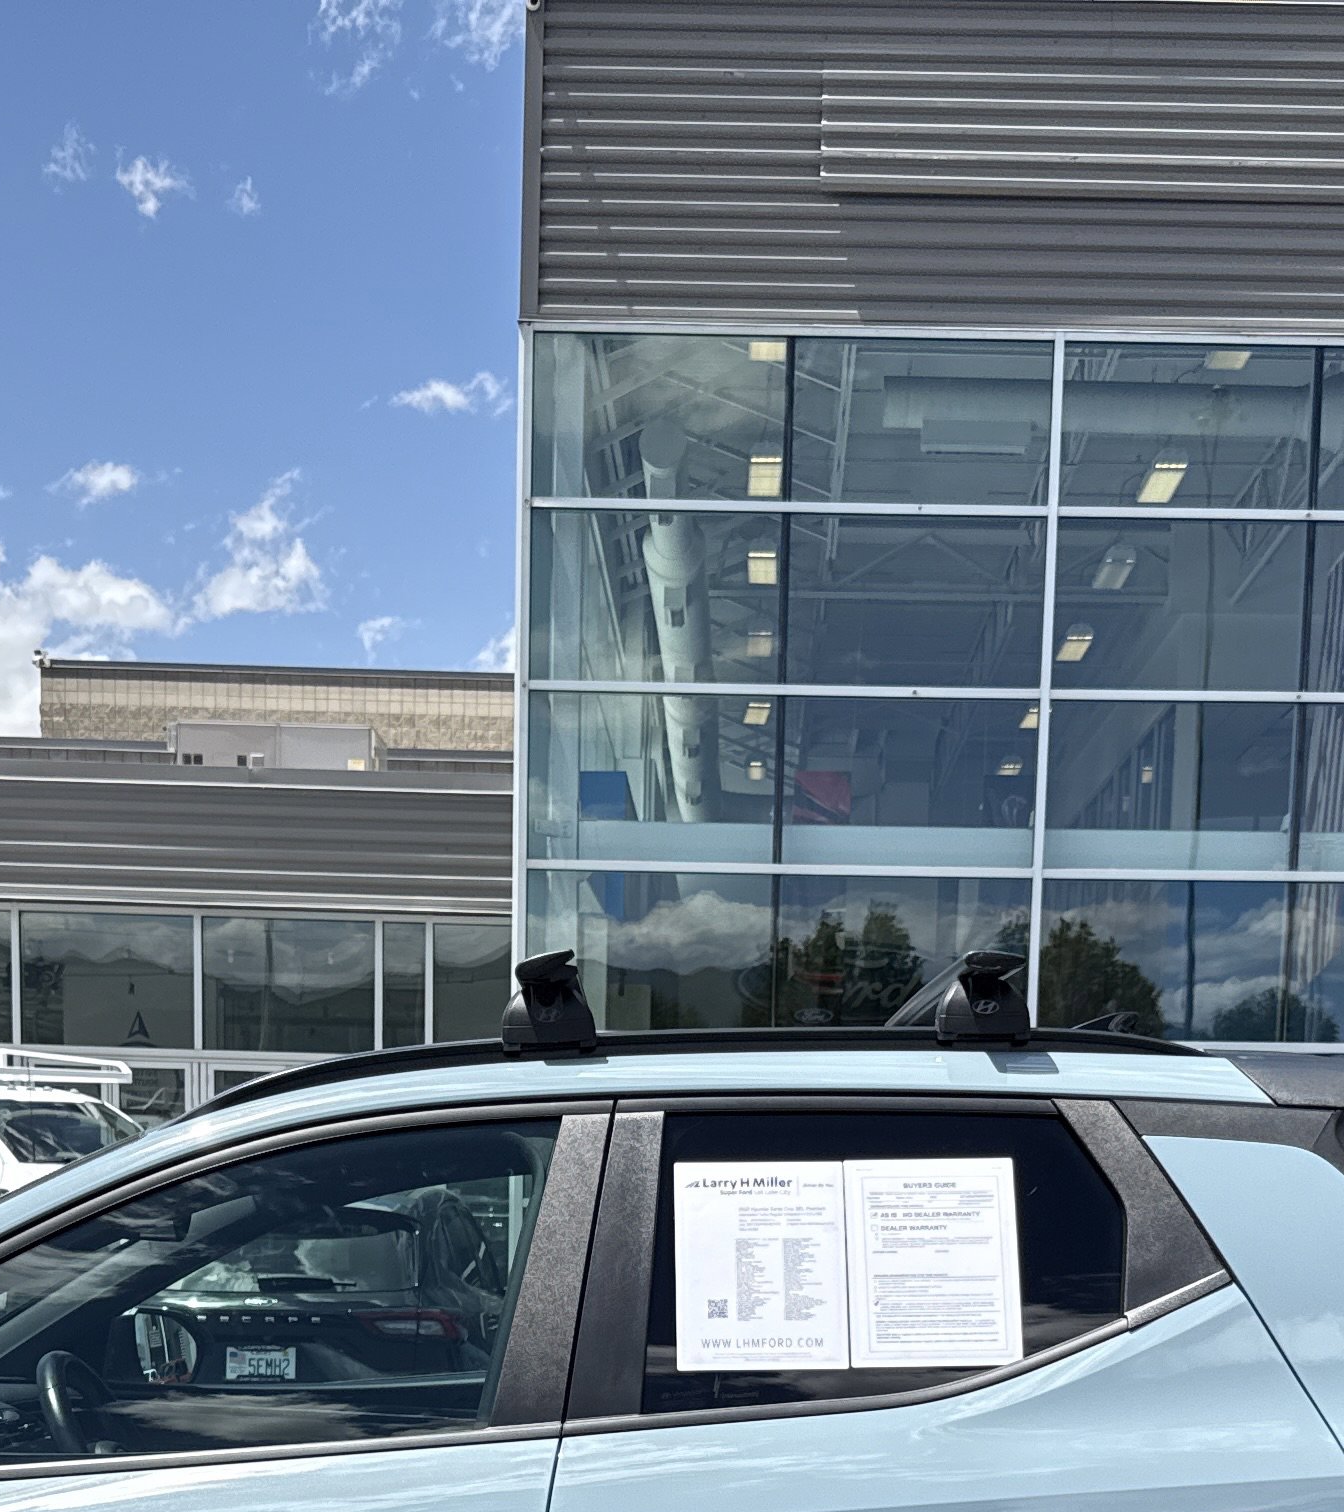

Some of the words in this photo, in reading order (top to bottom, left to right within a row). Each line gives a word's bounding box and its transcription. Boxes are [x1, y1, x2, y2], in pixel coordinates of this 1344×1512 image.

[702, 1177, 738, 1190] Larry
[740, 1177, 750, 1188] H
[753, 1175, 793, 1188] Miller
